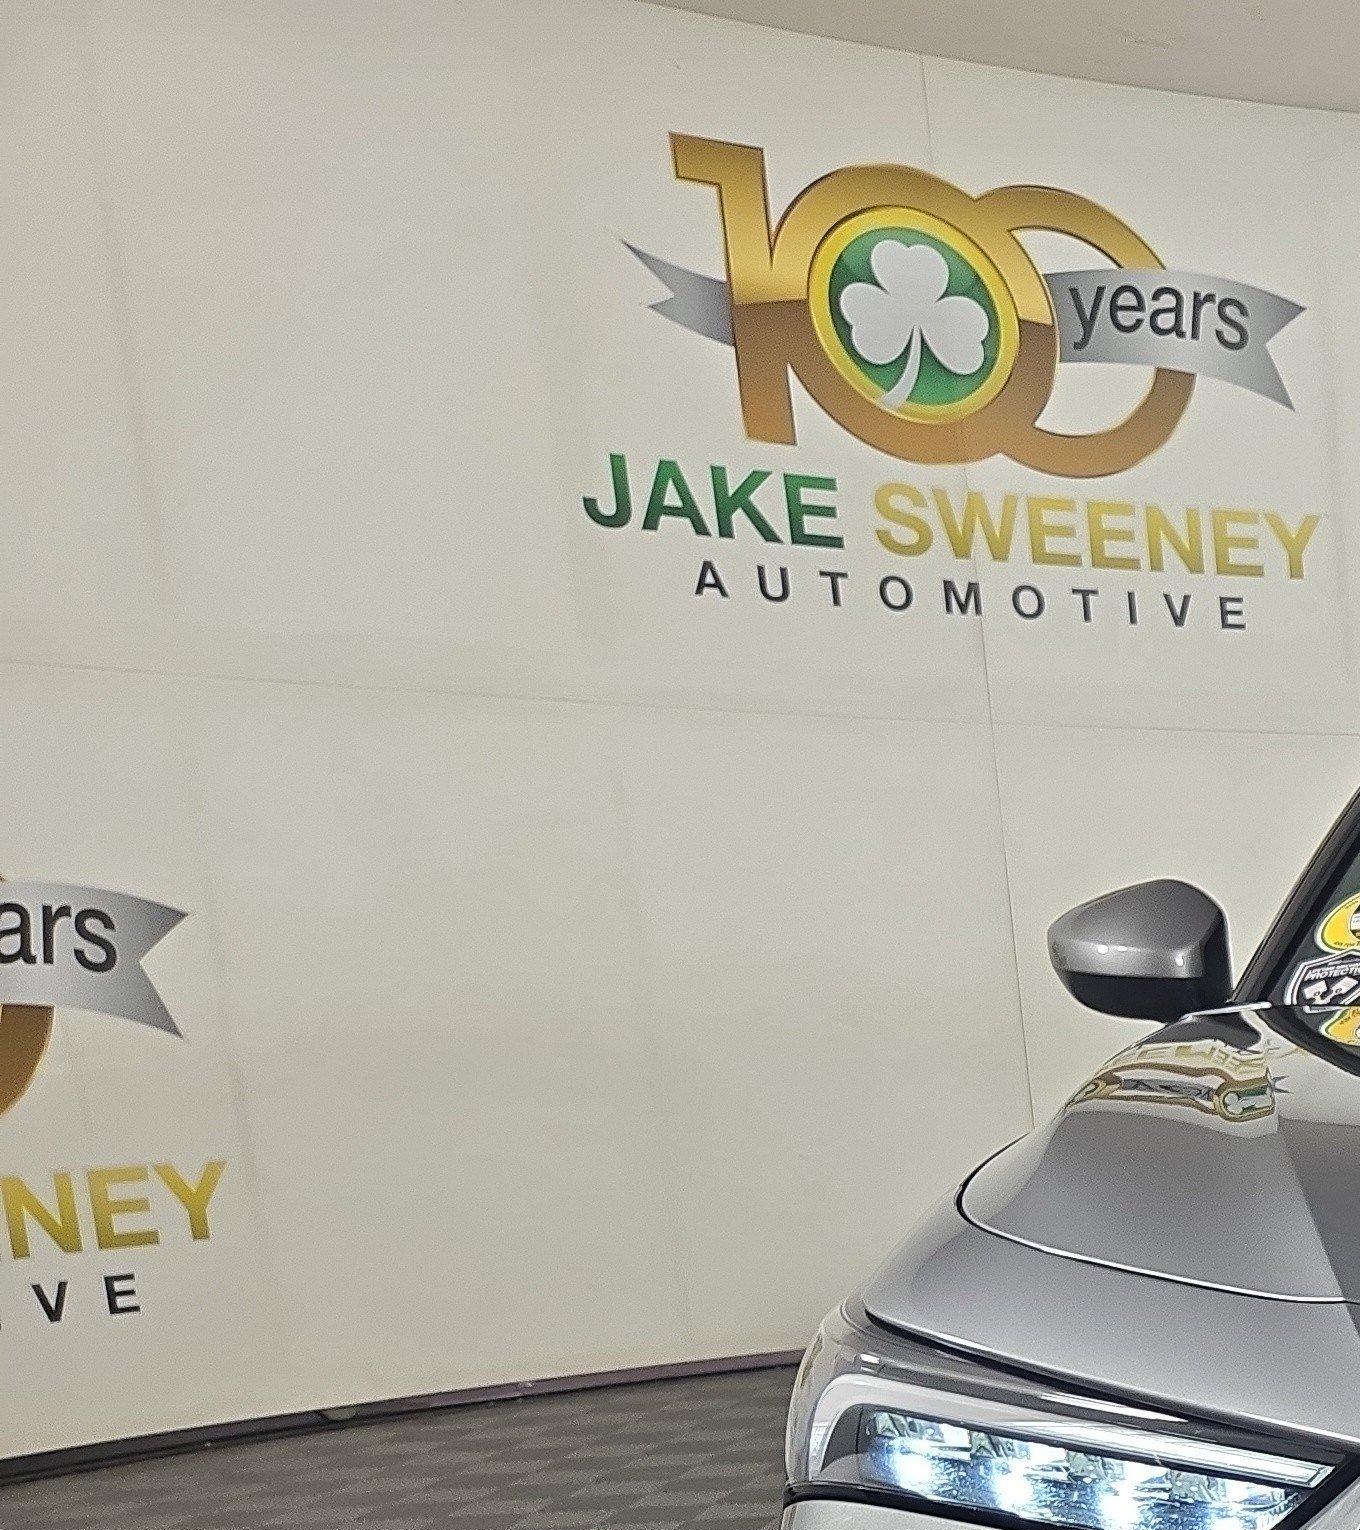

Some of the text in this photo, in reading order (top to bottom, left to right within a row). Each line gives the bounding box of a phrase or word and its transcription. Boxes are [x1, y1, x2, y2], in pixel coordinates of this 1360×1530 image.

[1067, 276, 1251, 352] years
[582, 452, 1321, 580] JAKE SWEENEY
[694, 559, 1247, 631] AUTOMOTIVE
